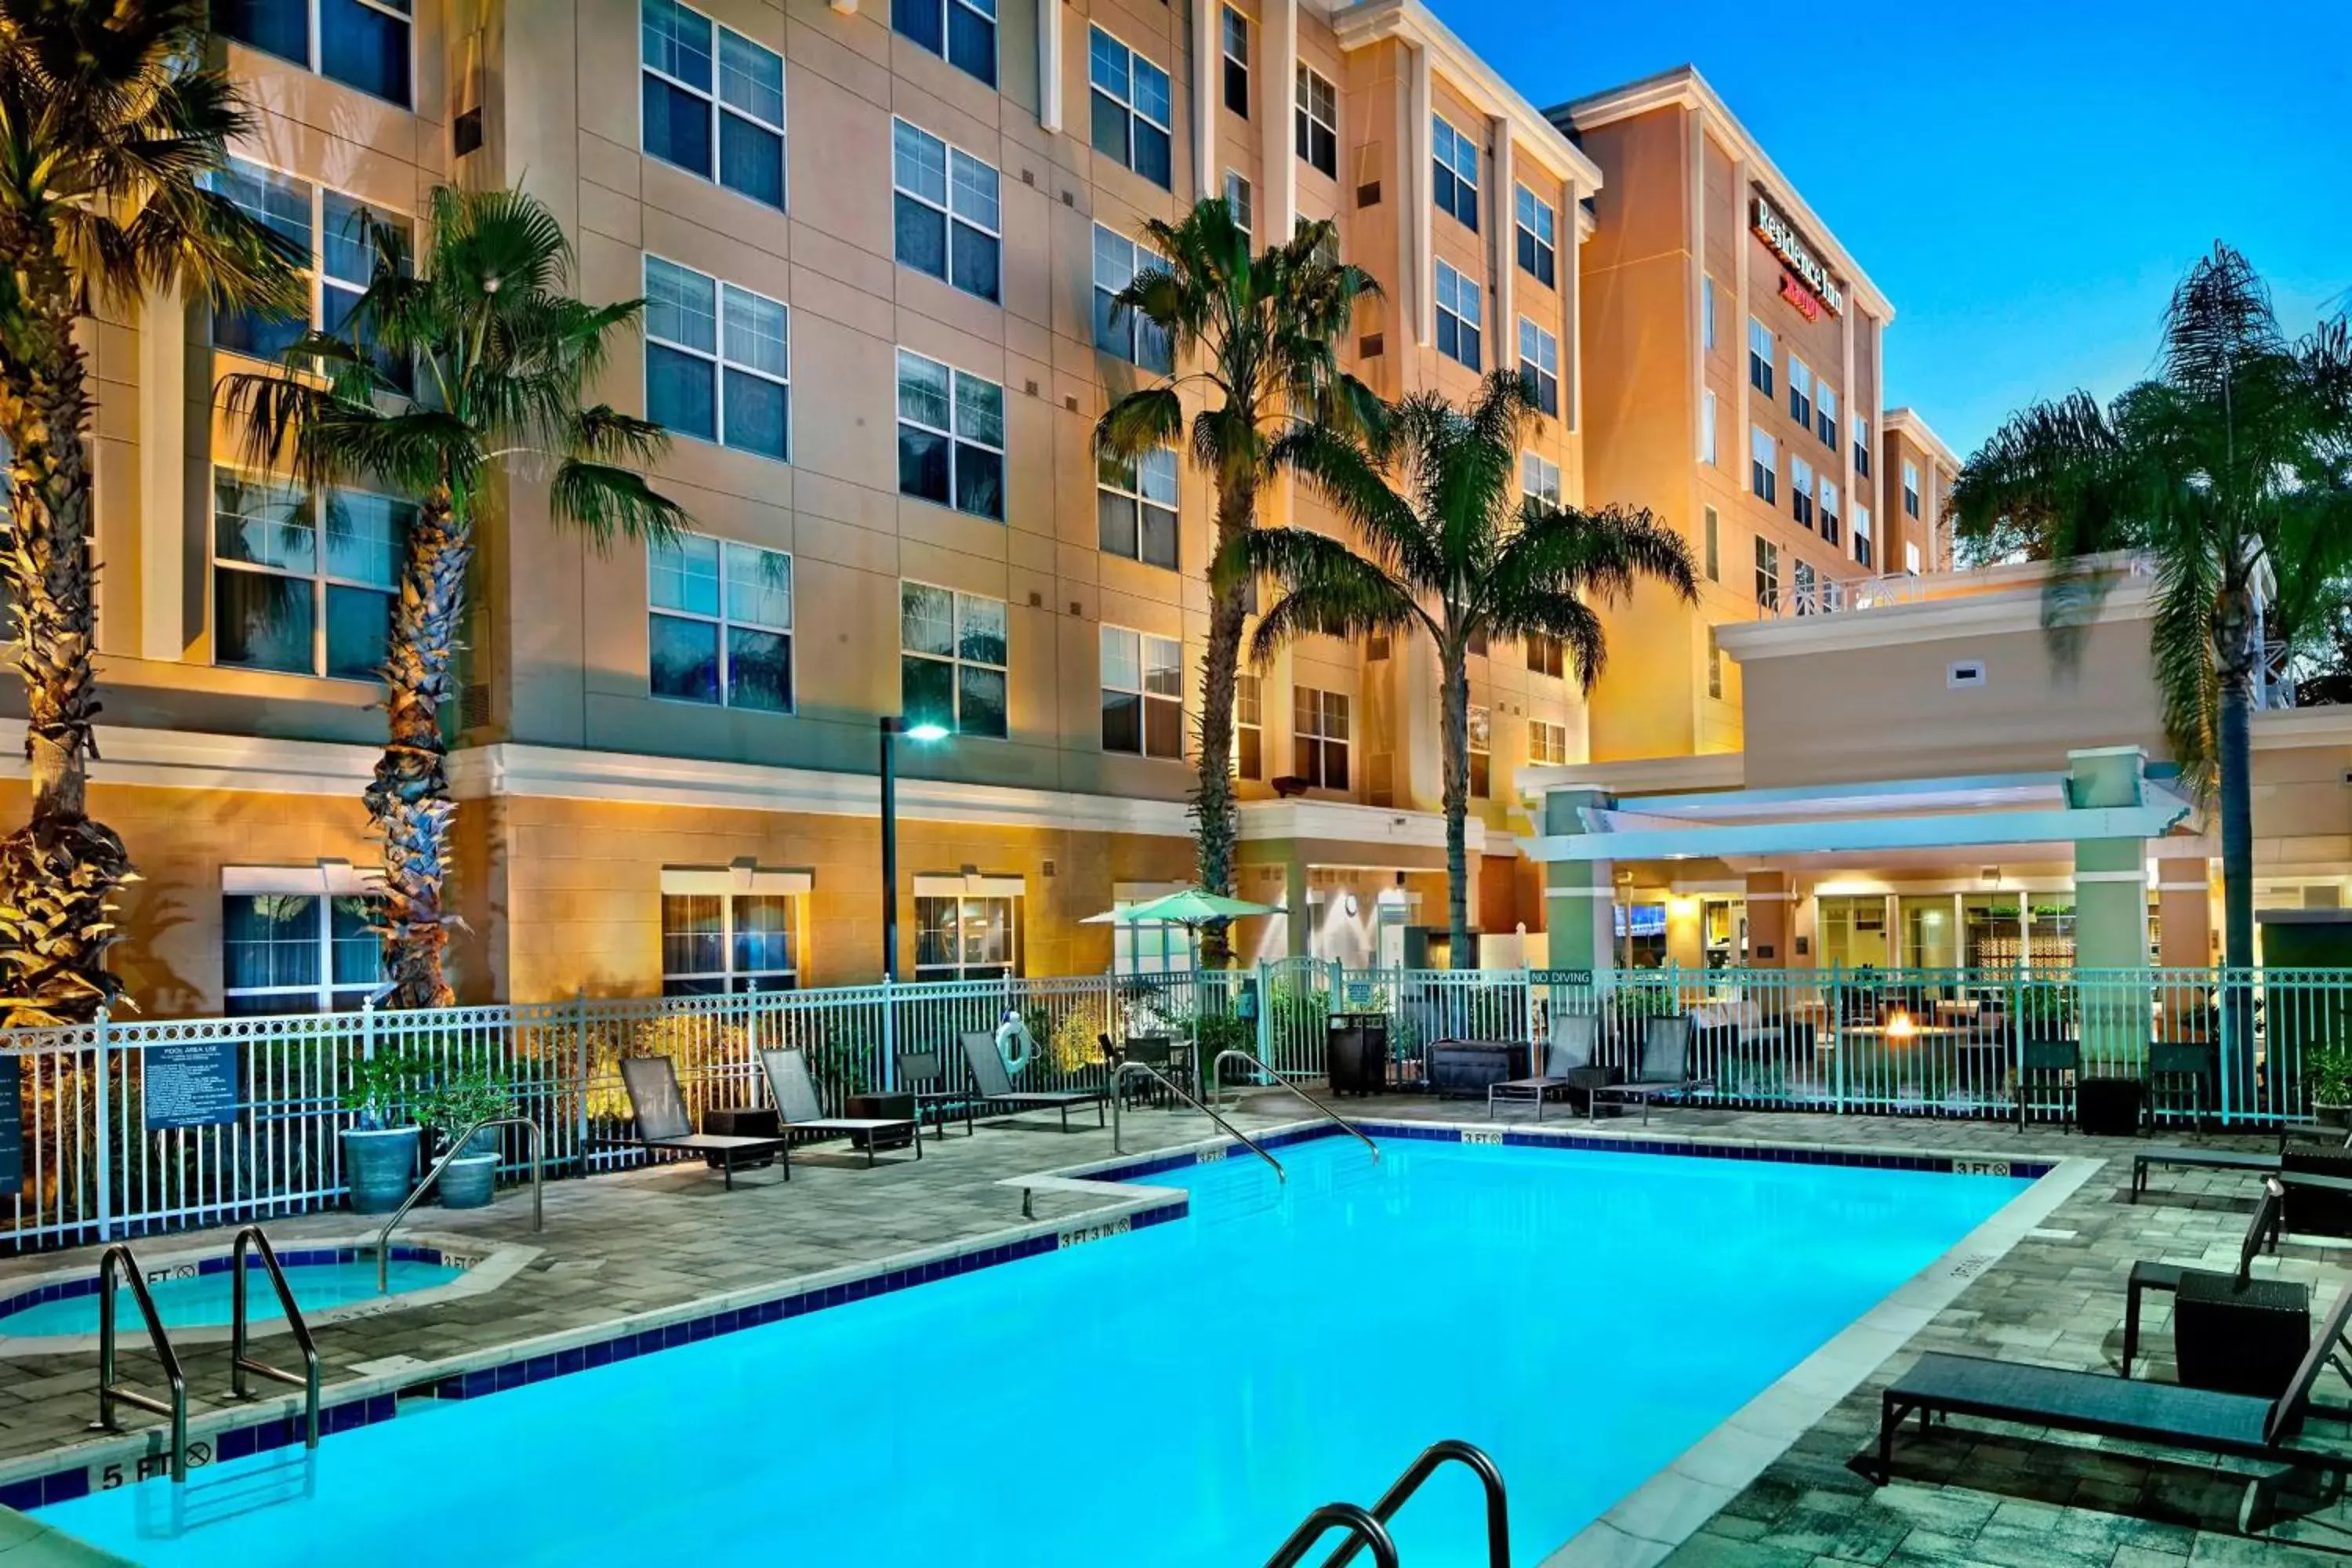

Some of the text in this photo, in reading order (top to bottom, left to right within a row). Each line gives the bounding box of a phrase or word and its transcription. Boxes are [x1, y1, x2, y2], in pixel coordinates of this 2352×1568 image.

[1759, 197, 1821, 291] Residence
[1821, 267, 1843, 316] Inn
[1531, 972, 1590, 983] NO DIVING
[1465, 1133, 1487, 1145] 3 FT
[1957, 1162, 1991, 1176] 3 FT
[1062, 1221, 1114, 1249] 3 FT 3 IN
[455, 1256, 466, 1269] FT
[147, 1269, 171, 1283] FT
[103, 1450, 173, 1490] 5 FT
